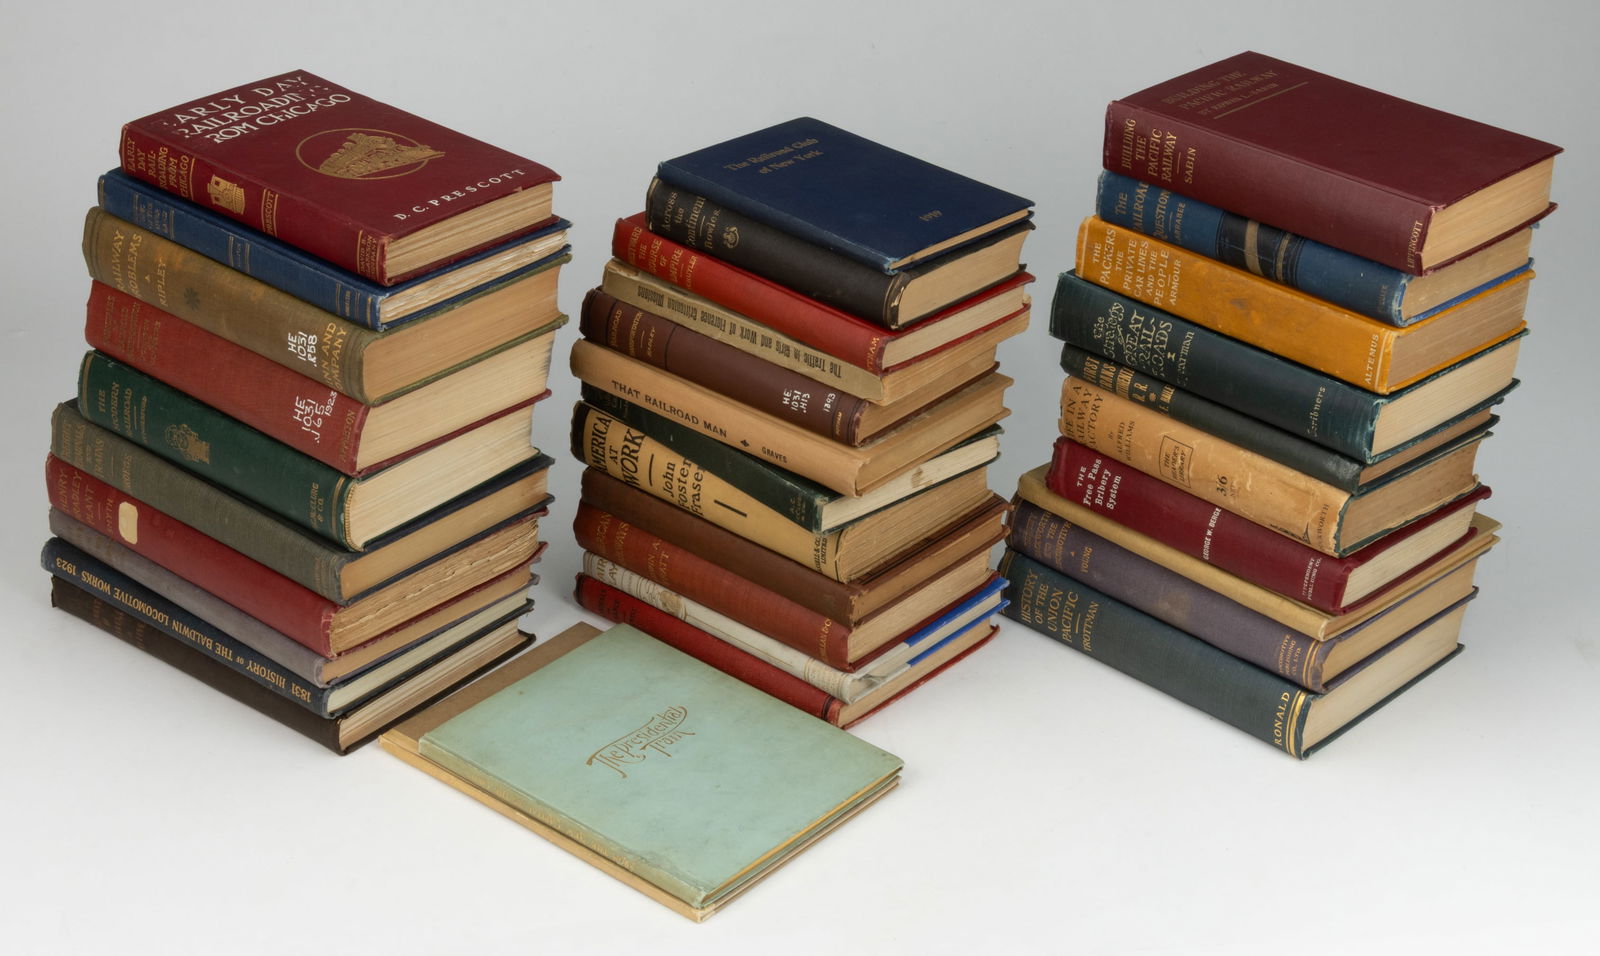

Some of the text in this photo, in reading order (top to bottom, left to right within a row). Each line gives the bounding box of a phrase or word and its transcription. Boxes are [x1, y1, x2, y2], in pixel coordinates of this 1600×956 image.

[256, 94, 351, 125] CHICAGO
[128, 138, 136, 172] EARLY
[137, 149, 146, 171] DAY
[1121, 119, 1137, 170] BUILDING
[1136, 136, 1147, 161] THE
[1147, 128, 1163, 177] PACIFIC
[1162, 131, 1177, 183] RAILWAY
[169, 157, 178, 188] FROM
[180, 155, 189, 198] CHICAGO
[1185, 147, 1197, 184] SABIN
[429, 168, 527, 207] PRESCOTT
[1115, 191, 1128, 215] THE
[264, 190, 274, 235] PRESCOTT
[661, 191, 678, 232] Across
[704, 209, 721, 249] Bowles
[1408, 219, 1424, 269] LIPPINCOTT
[639, 243, 648, 260] THE
[1093, 242, 1102, 264] THE
[1100, 228, 1117, 285] PACKERS
[1115, 250, 1124, 272] THE
[1123, 239, 1138, 291] PRIVATE
[1134, 239, 1150, 298] CAR LINES
[1146, 250, 1158, 296] AND THE
[1154, 249, 1170, 306] PEOPLE
[1169, 259, 1182, 306] ARMOUR
[701, 310, 727, 332] Florence
[729, 321, 737, 336] of
[740, 326, 757, 345] Work
[287, 332, 298, 353] HE
[297, 331, 308, 361] 1031
[321, 322, 337, 357] AND
[761, 334, 773, 348] and
[793, 347, 801, 360] in
[1125, 309, 1145, 367] GREAT
[804, 352, 826, 373] Traffic
[829, 361, 841, 379] The
[1365, 333, 1380, 385] ALTEMUS
[98, 390, 106, 413] THE
[293, 395, 306, 422] HE
[324, 390, 338, 417] 1923
[782, 388, 793, 405] HE
[791, 390, 802, 412] 1031
[1067, 385, 1082, 417] IN A
[302, 398, 316, 432] 1031
[611, 379, 641, 400] THAT
[645, 394, 699, 427] RAILROAD
[703, 420, 728, 439] MAN
[761, 446, 788, 464] GRAVES
[1087, 392, 1104, 451] ACTORY
[609, 445, 619, 466] AT
[620, 428, 647, 487] WORK
[1125, 420, 1136, 462] WILLIAMS
[663, 461, 676, 499] John
[1077, 465, 1087, 487] THE
[1083, 458, 1102, 507] Free Pass
[1095, 468, 1112, 507] Bribery
[1106, 474, 1122, 511] System
[1215, 474, 1229, 497] 3/6
[1203, 532, 1212, 561] GEORGE
[1206, 527, 1214, 537] W.
[56, 556, 77, 576] 1923
[1081, 546, 1093, 574] YOUNG
[81, 570, 111, 595] WORKS
[1020, 567, 1039, 624] HISTORY
[113, 586, 169, 626] LOCOMOTIVE
[1034, 582, 1049, 625] OF THE
[1047, 587, 1065, 633] UNION
[1062, 591, 1079, 644] PACIFIC
[172, 618, 213, 650] BALDWIN
[1082, 601, 1099, 652] TROTTMAN
[215, 642, 233, 662] THE
[246, 660, 286, 689] HISTORY
[291, 682, 312, 703] 1831
[1274, 690, 1291, 747] RONALD
[645, 731, 696, 758] Train
